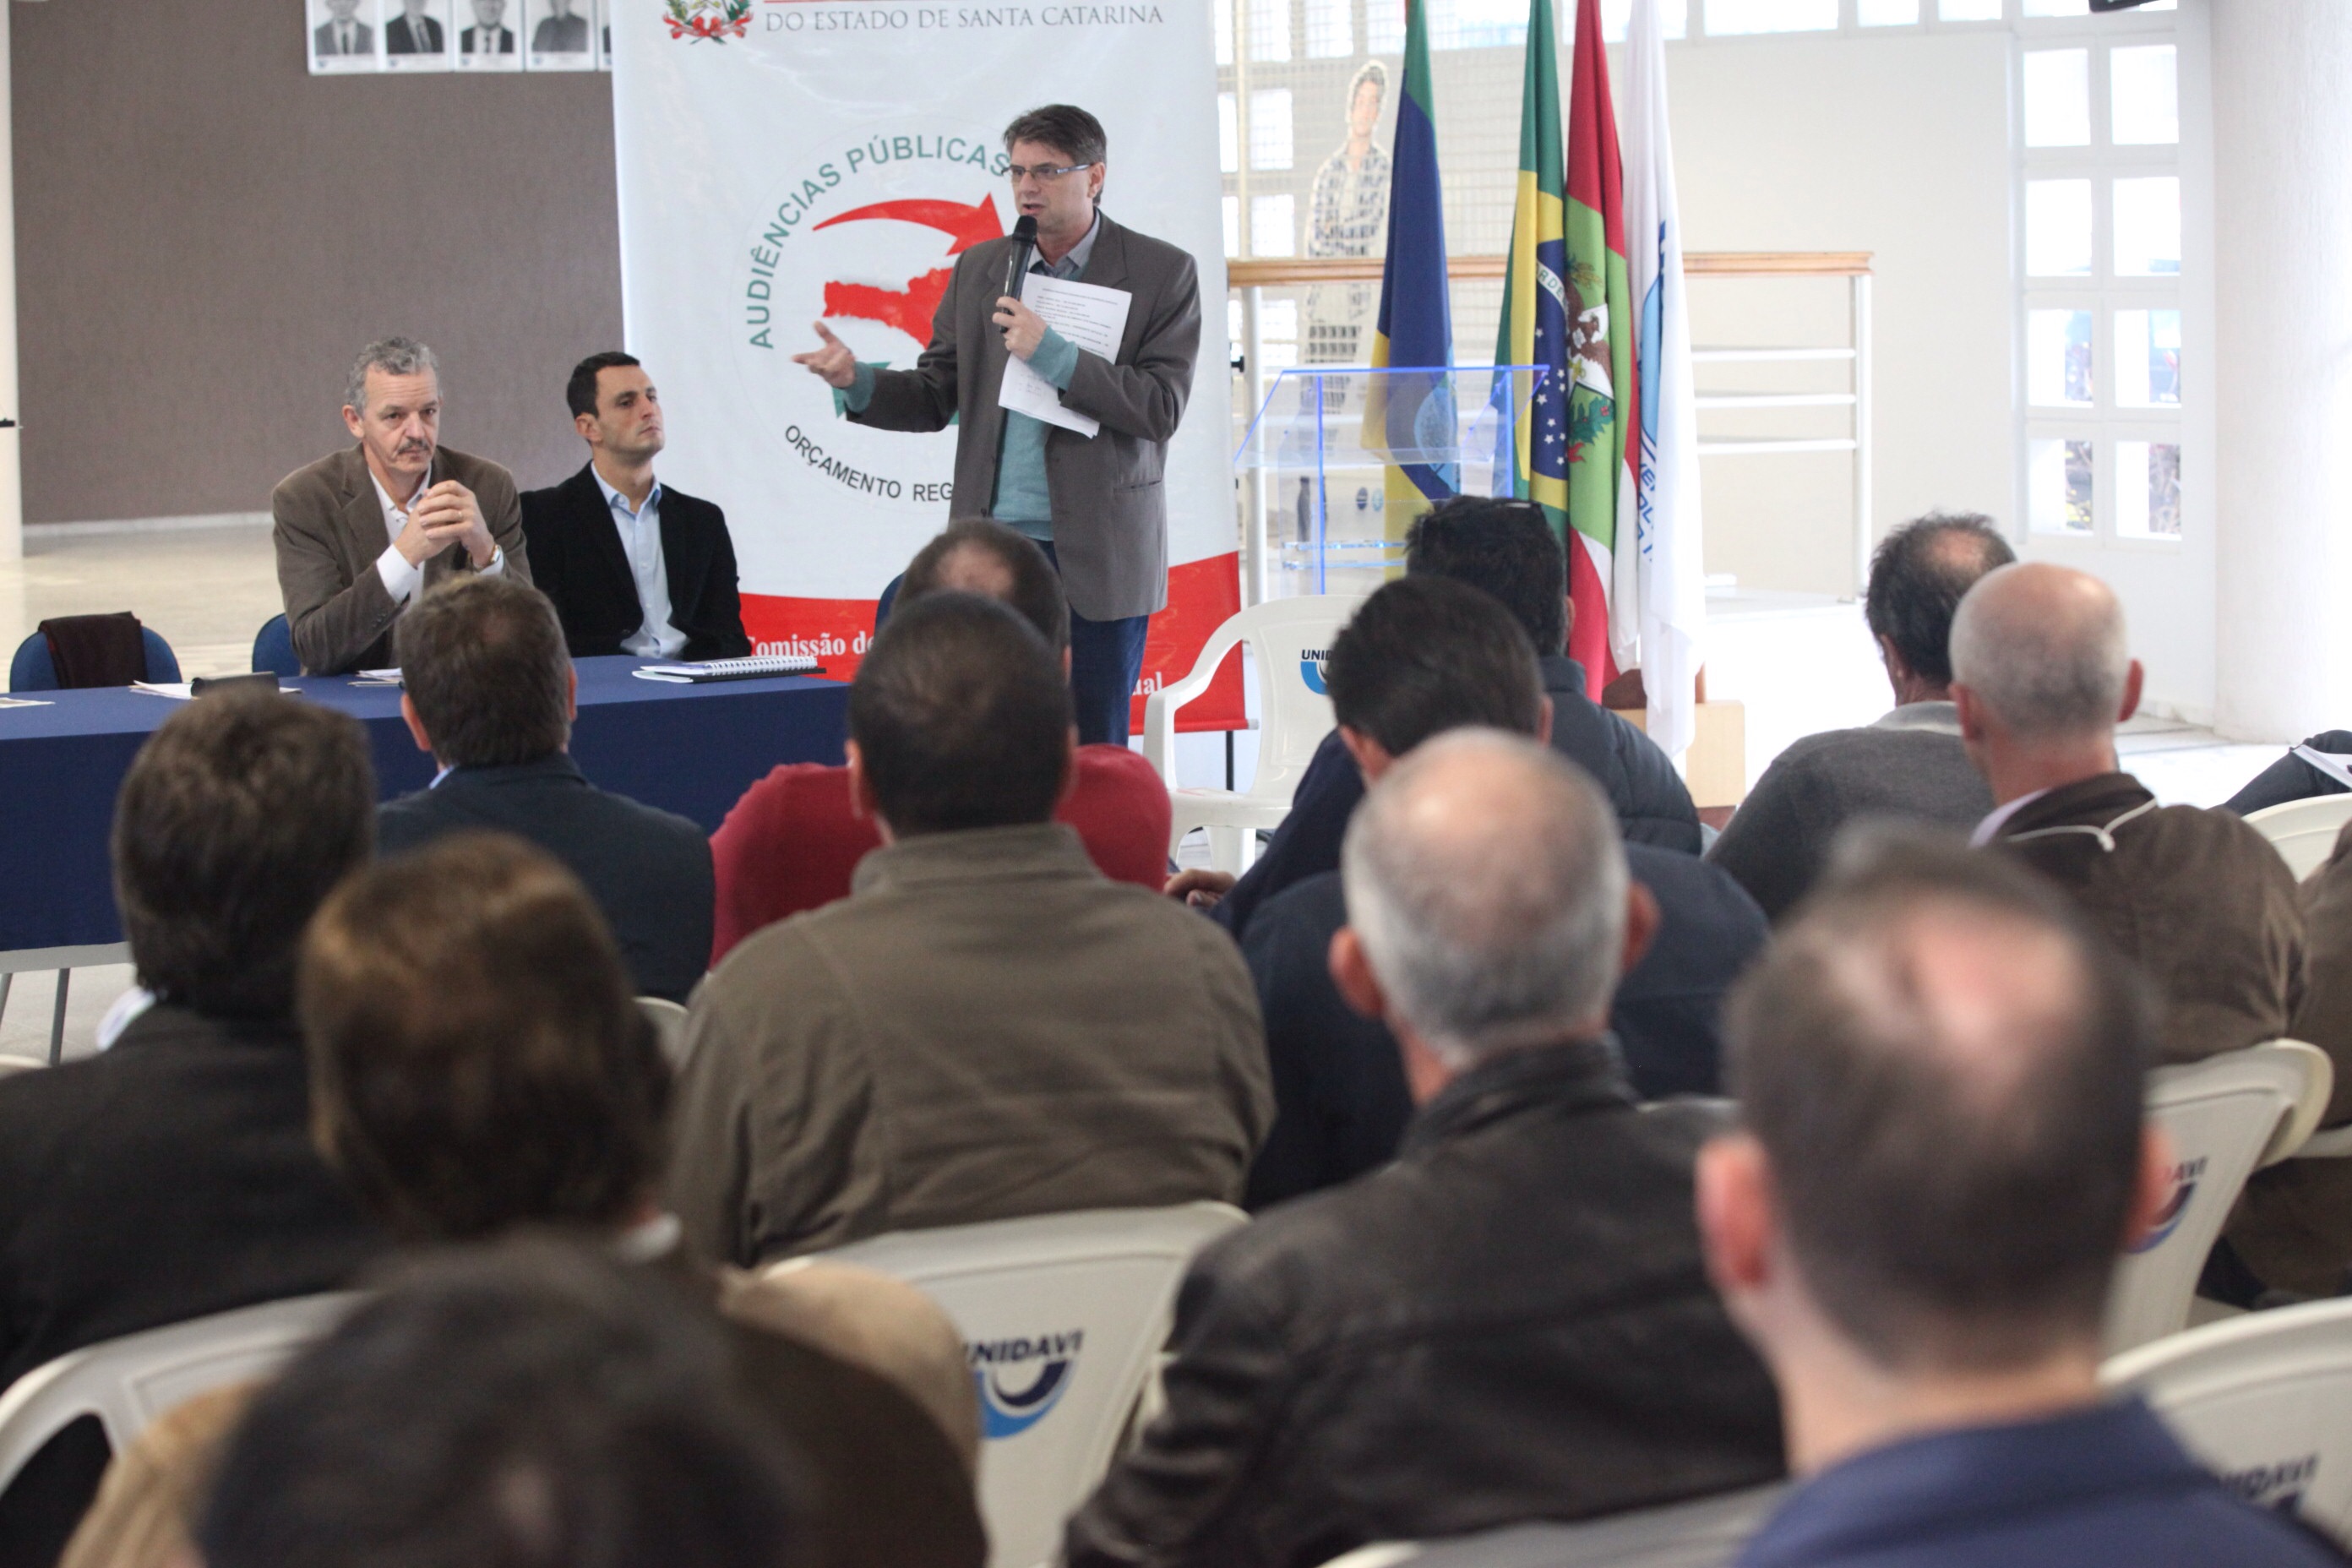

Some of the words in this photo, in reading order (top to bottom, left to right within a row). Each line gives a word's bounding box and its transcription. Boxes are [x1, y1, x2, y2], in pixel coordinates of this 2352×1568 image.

[765, 12, 804, 32] DO
[814, 9, 909, 30] ESTADO
[917, 9, 950, 29] DE
[956, 8, 1034, 28] SANTA
[1041, 5, 1164, 26] CATARINA
[746, 162, 841, 350] AUDIÊNCIAS
[845, 134, 1011, 177] PÚBLICAS
[785, 425, 901, 499] ORÇAMENTO
[913, 482, 953, 502] REG
[964, 1327, 1084, 1364] NIDAVI
